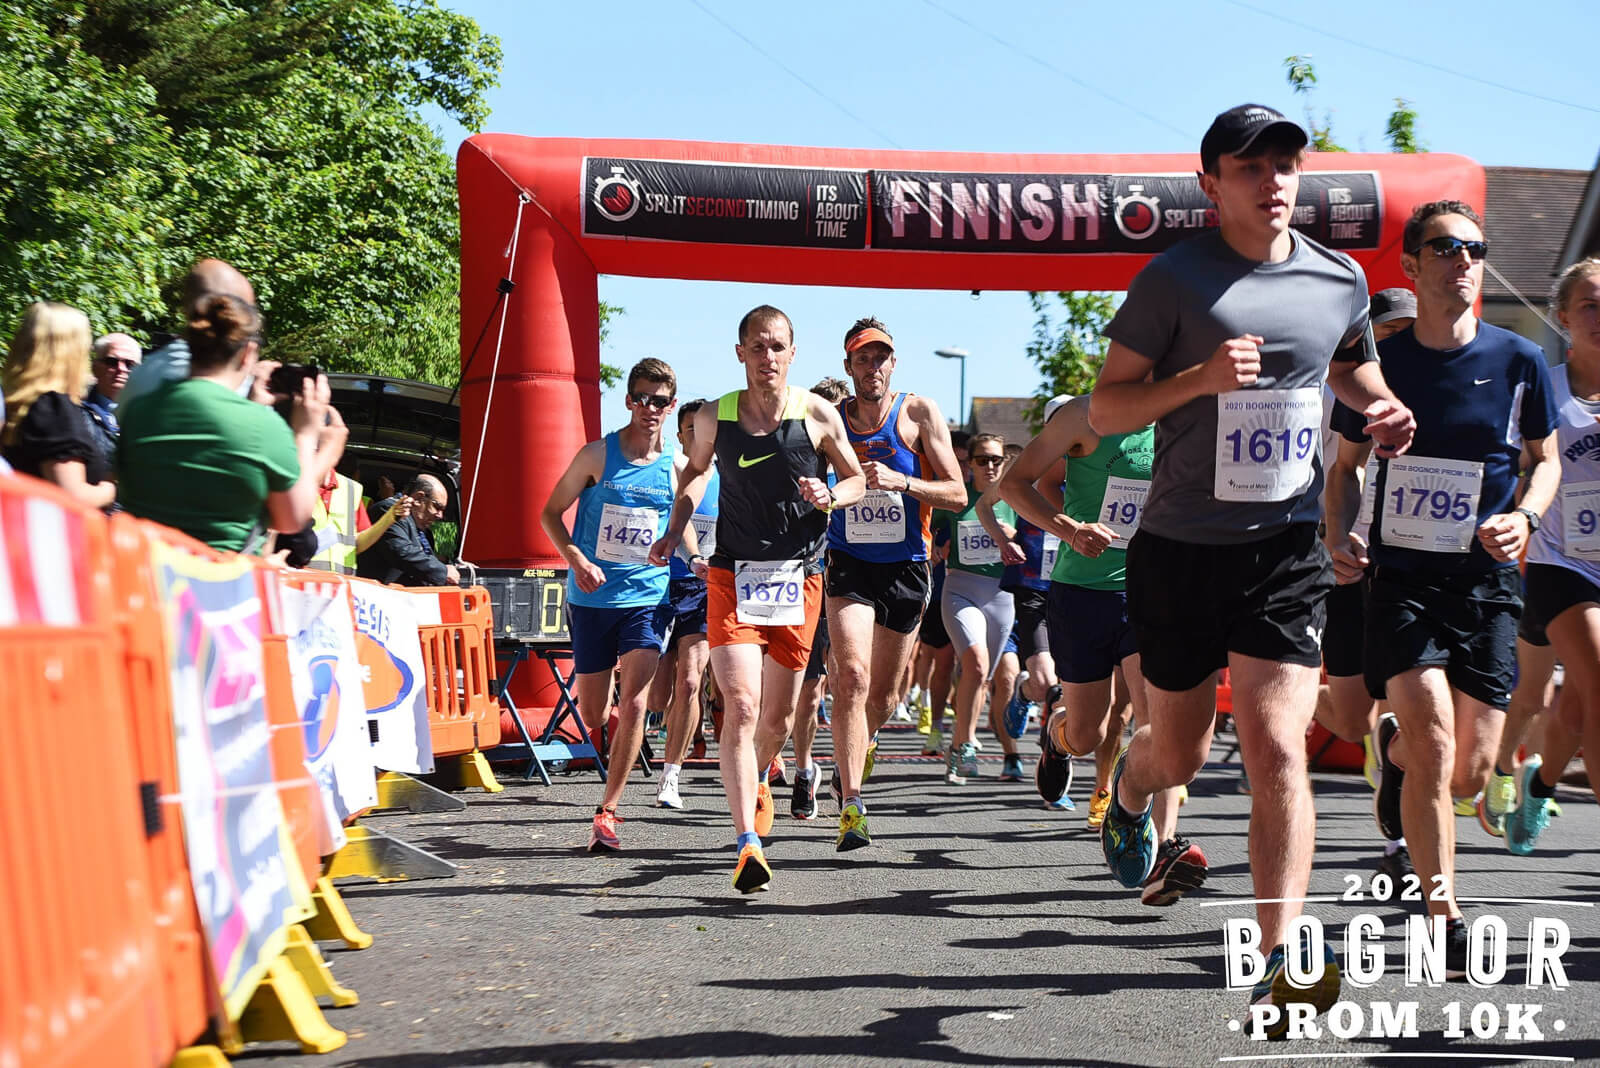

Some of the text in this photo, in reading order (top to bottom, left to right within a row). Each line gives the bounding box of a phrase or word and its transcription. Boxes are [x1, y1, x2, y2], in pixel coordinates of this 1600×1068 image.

[816, 185, 837, 201] ITS
[1327, 188, 1352, 203] ITS
[815, 202, 860, 220] ABOUT
[890, 180, 1099, 241] FINISH
[1328, 204, 1375, 221] ABOUT
[816, 220, 847, 238] TIME
[1330, 222, 1363, 239] TIME
[1245, 401, 1281, 410] BOGNOR
[1225, 428, 1312, 463] 1619
[603, 480, 624, 490] Run
[626, 483, 670, 497] Academy
[1391, 486, 1472, 521] 1795
[849, 505, 902, 523] 1046
[1107, 501, 1143, 525] 19
[603, 524, 654, 547] 1473
[740, 581, 799, 603] 1679
